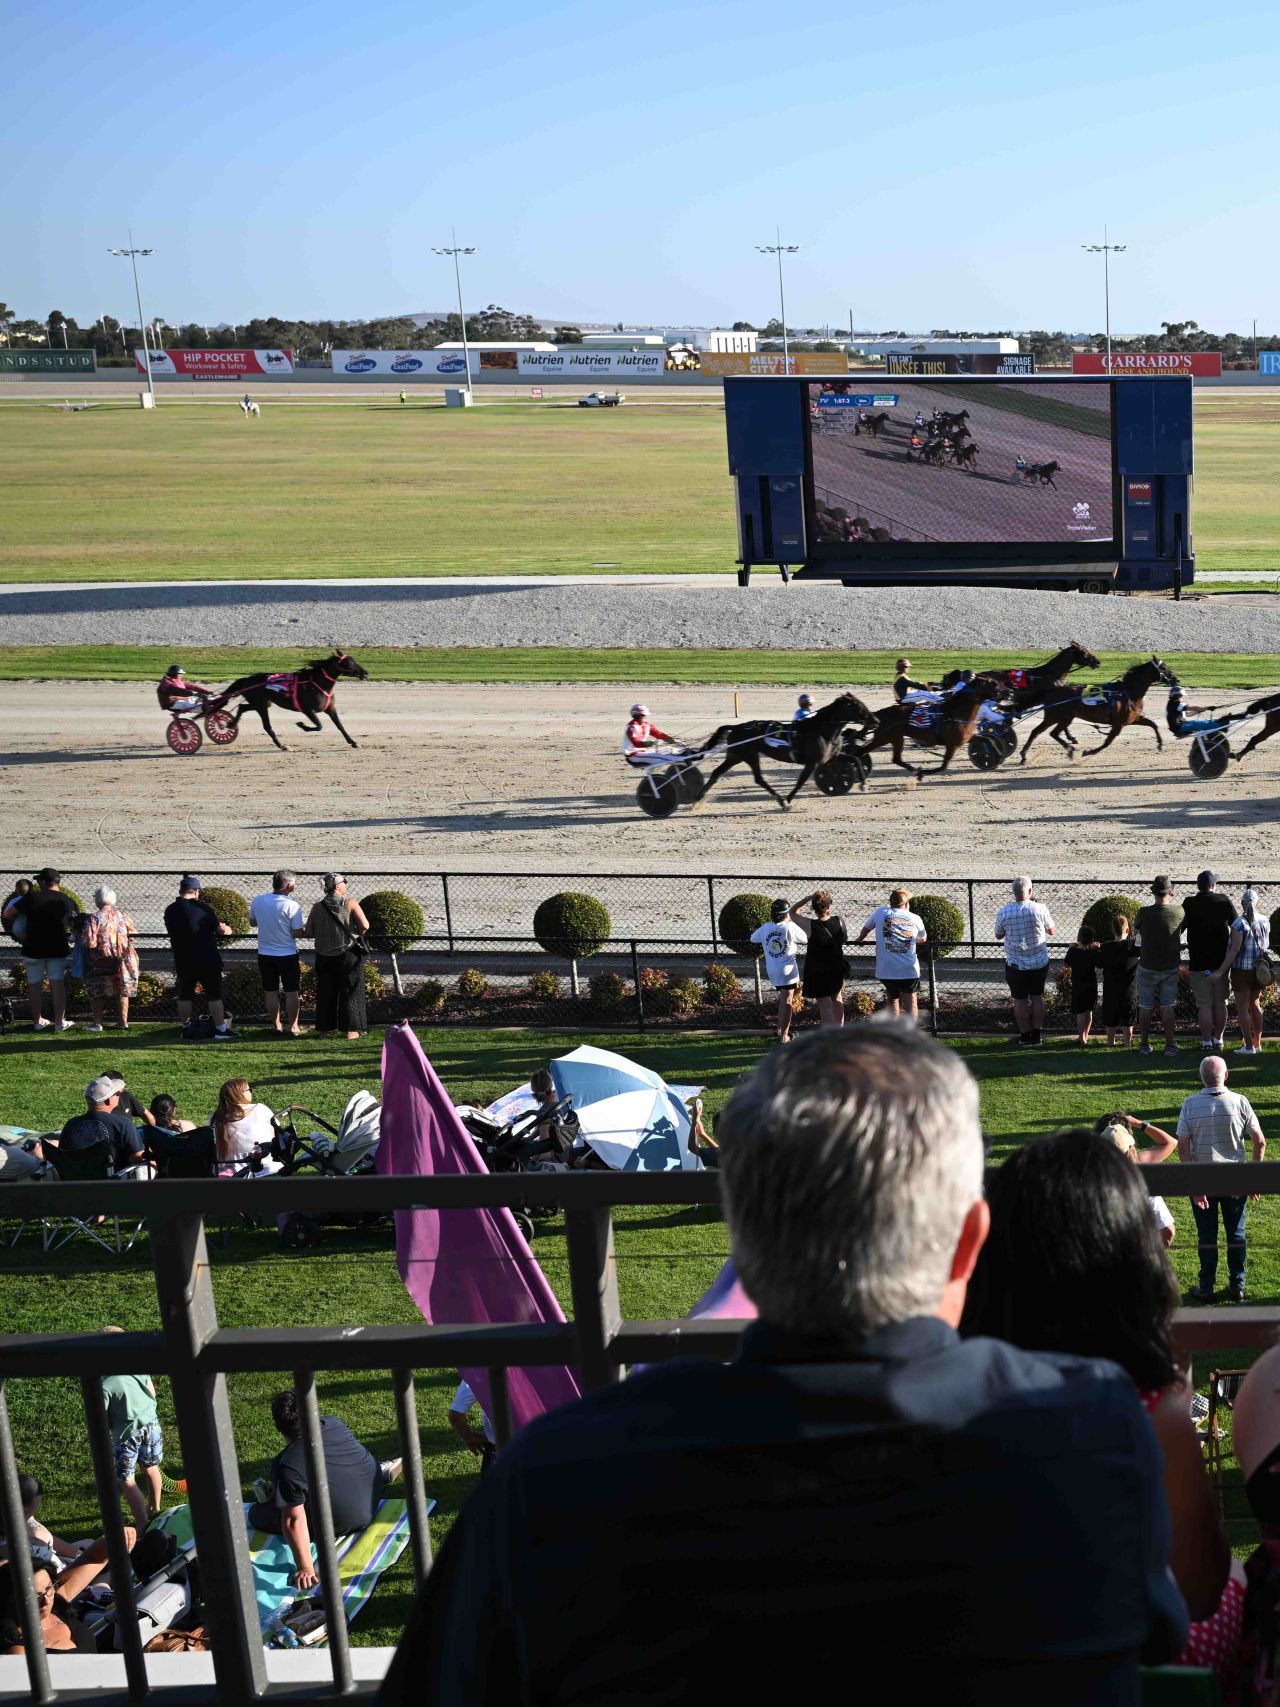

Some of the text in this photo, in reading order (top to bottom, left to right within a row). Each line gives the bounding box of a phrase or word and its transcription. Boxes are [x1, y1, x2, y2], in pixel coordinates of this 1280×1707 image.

[45, 357, 90, 366] STUD
[183, 353, 246, 362] HIP POCKET
[523, 354, 564, 365] Nutrien
[569, 354, 611, 365] Nutrien
[617, 354, 659, 365] Nutrien
[1003, 356, 1032, 365] SIGNAGE
[1101, 355, 1192, 368] GARRARD'S
[750, 365, 776, 374] CITY
[889, 362, 946, 374] UNSEE THIS!
[996, 365, 1032, 374] AVAILABLE
